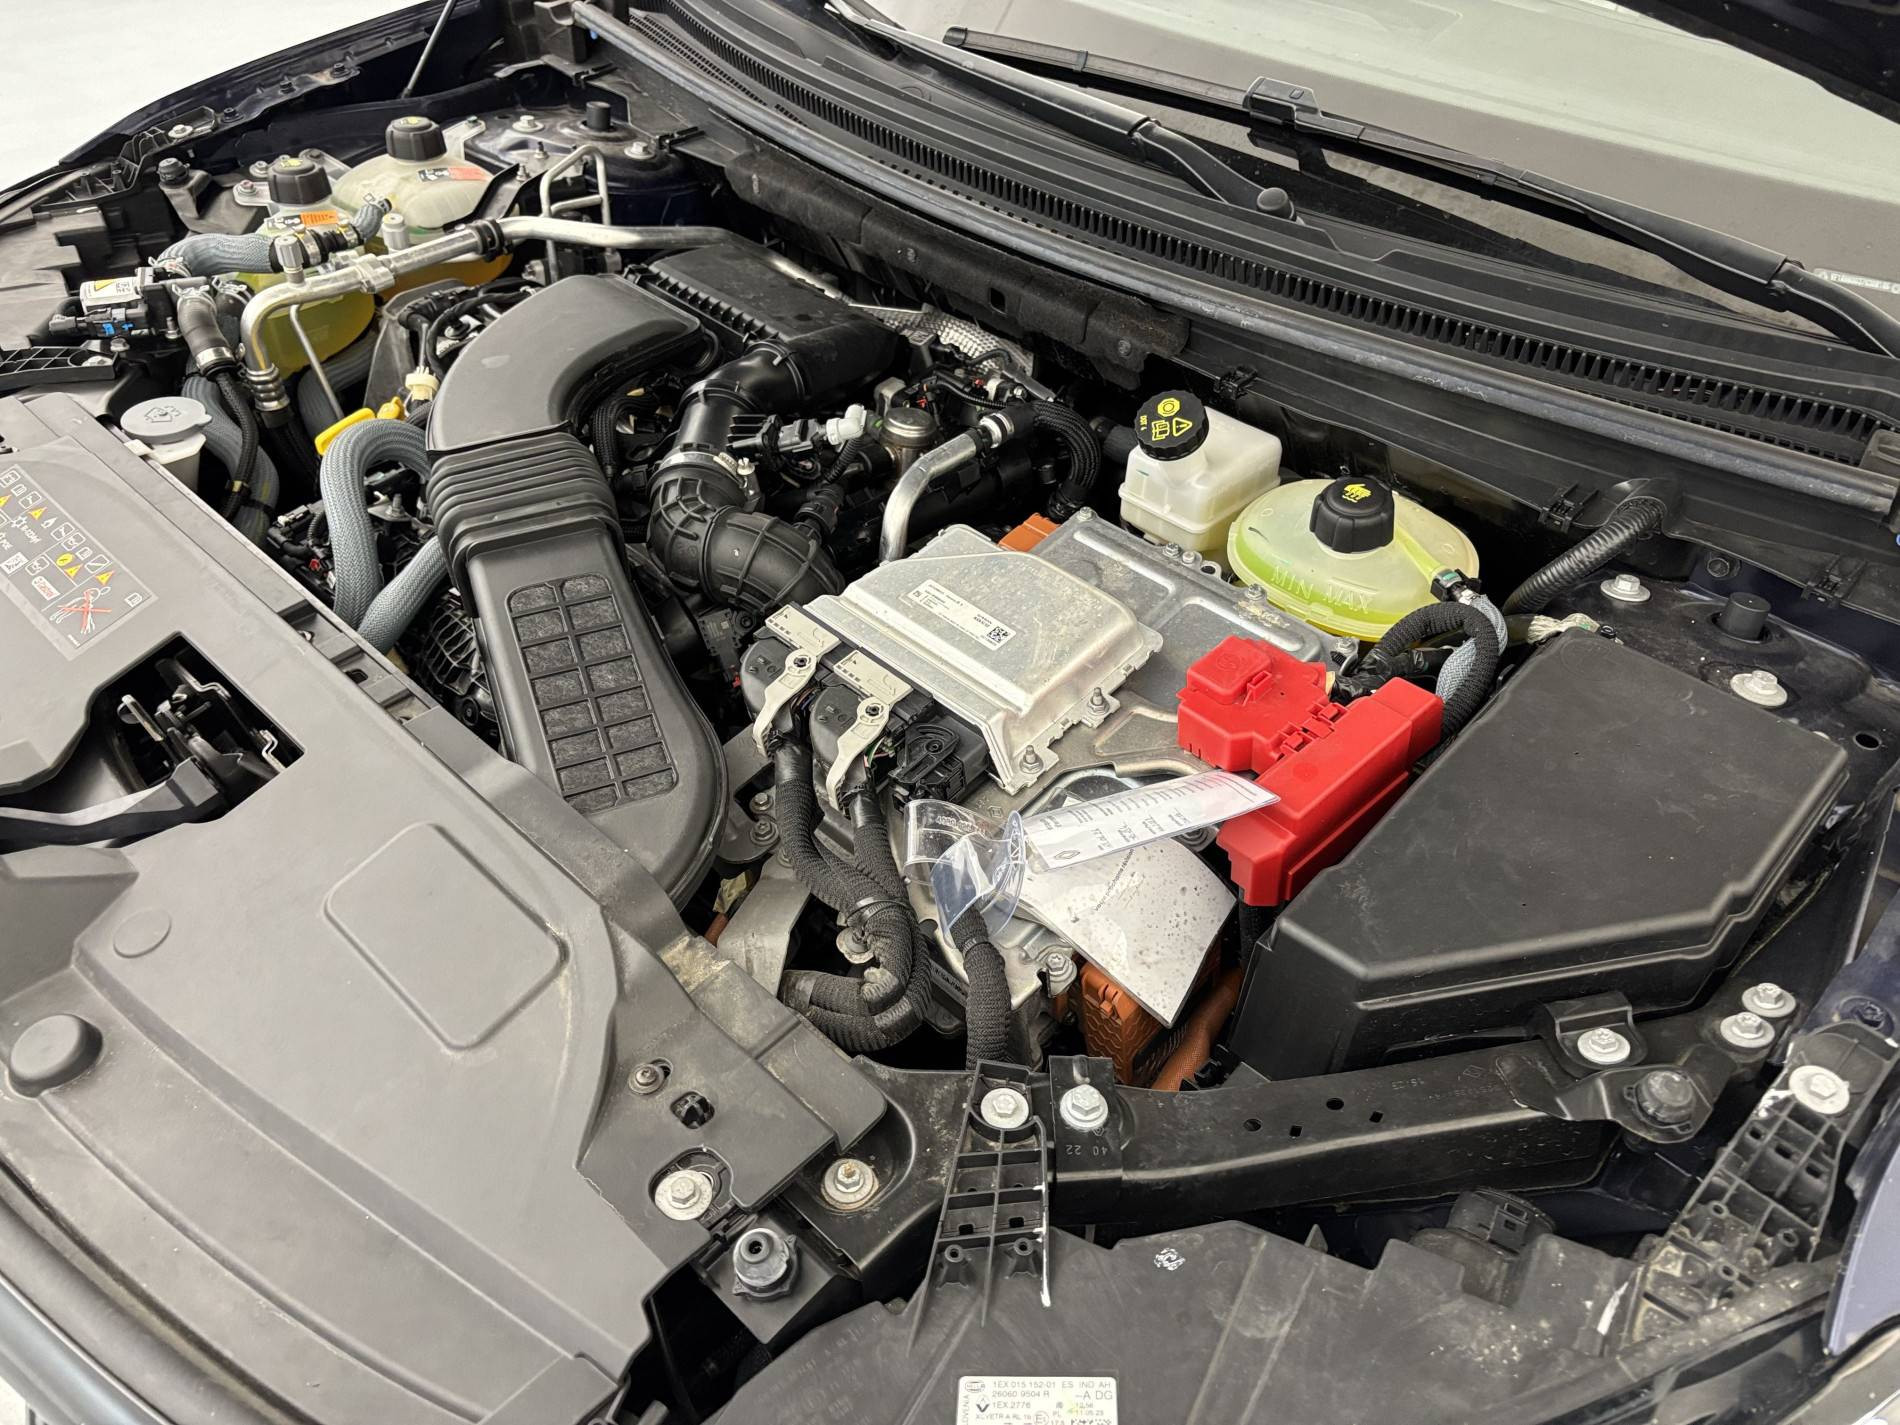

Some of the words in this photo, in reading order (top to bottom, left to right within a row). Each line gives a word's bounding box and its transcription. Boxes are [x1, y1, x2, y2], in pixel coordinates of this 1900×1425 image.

[1271, 565, 1314, 600] MIN
[1323, 583, 1372, 615] MAX
[992, 1390, 1018, 1398] 26060
[1095, 1390, 1113, 1400] DG
